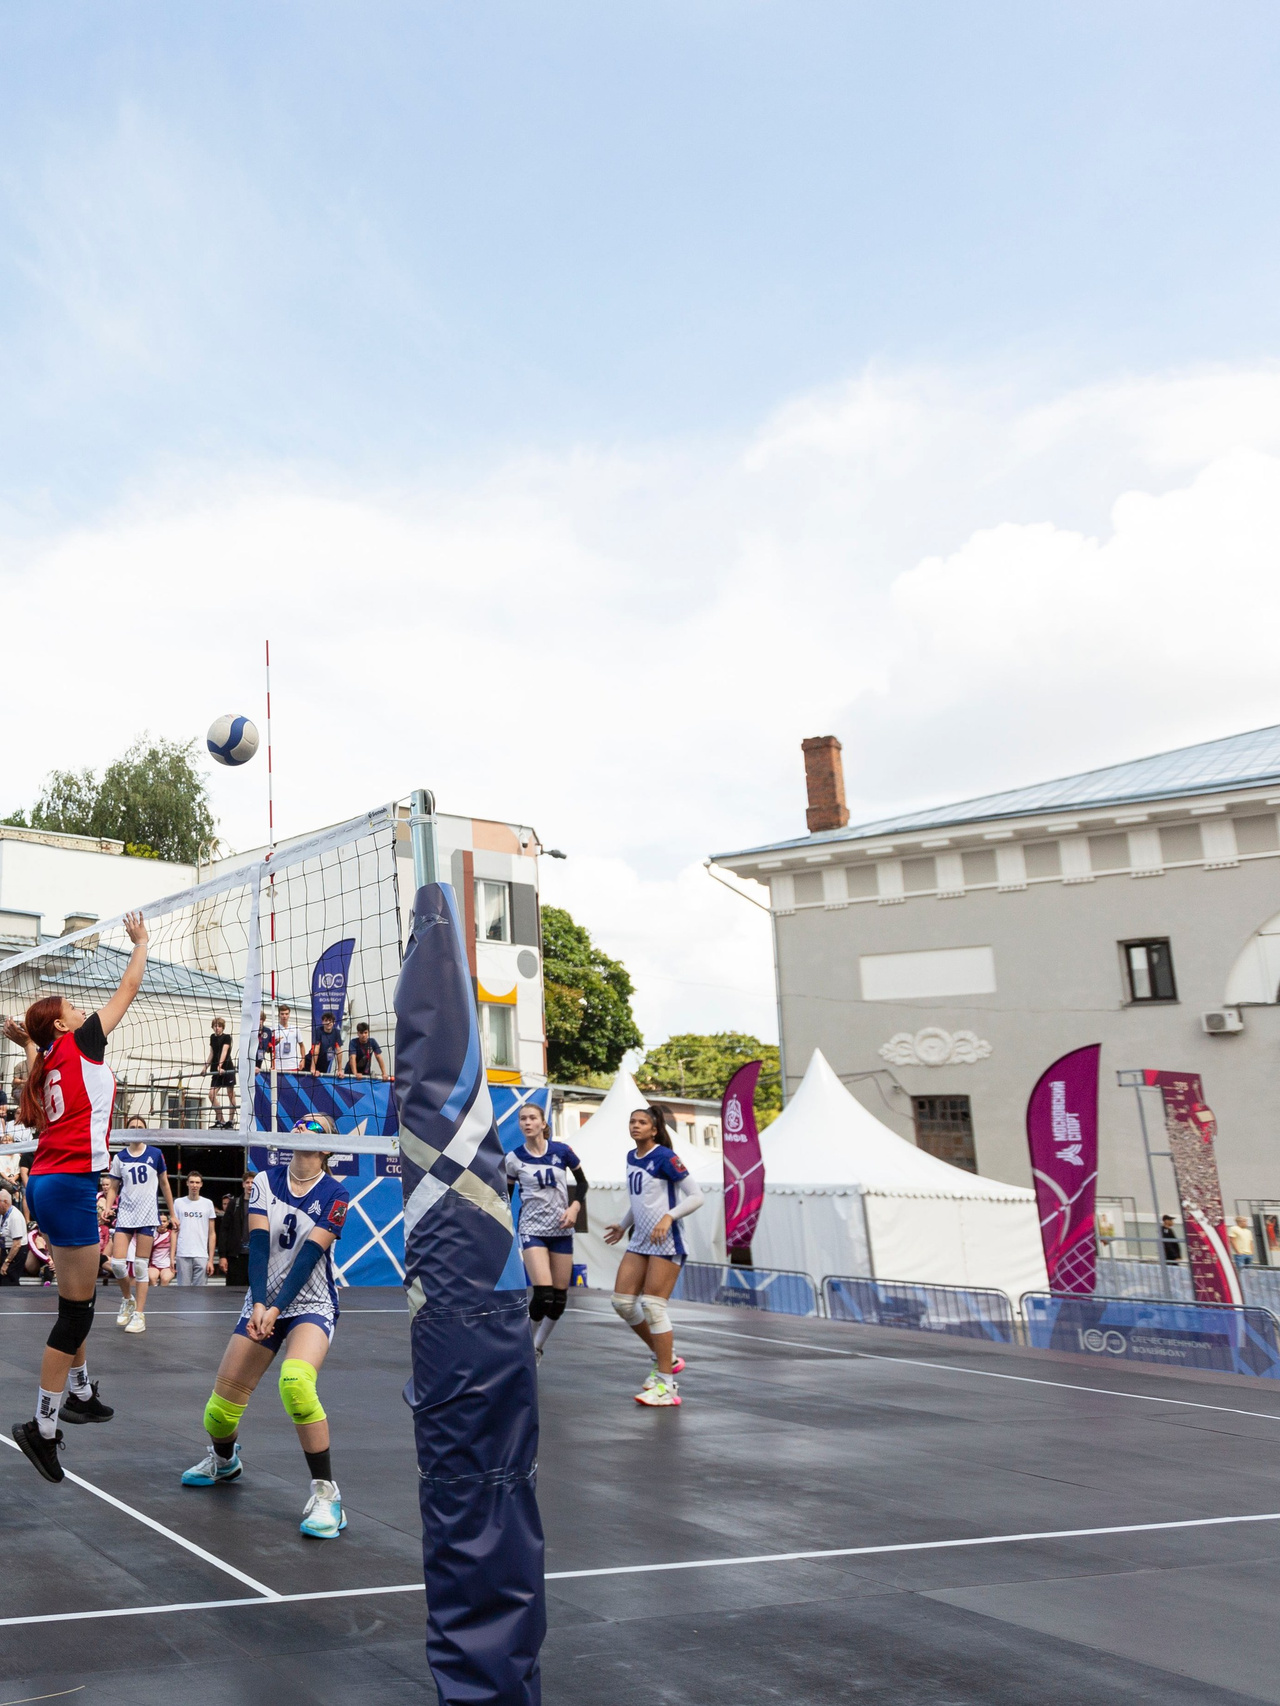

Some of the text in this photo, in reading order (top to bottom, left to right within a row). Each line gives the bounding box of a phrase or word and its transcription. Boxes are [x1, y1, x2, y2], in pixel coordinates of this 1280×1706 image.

[44, 1069, 65, 1122] 6
[1048, 1081, 1067, 1142] МОСКОВСКИЙ
[1066, 1112, 1082, 1141] СПОРТ
[128, 1165, 148, 1185] 18
[533, 1168, 557, 1190] 14
[628, 1171, 643, 1195] 10
[279, 1213, 297, 1249] 3
[1077, 1328, 1127, 1354] 100
[40, 1395, 51, 1416] PUMA
